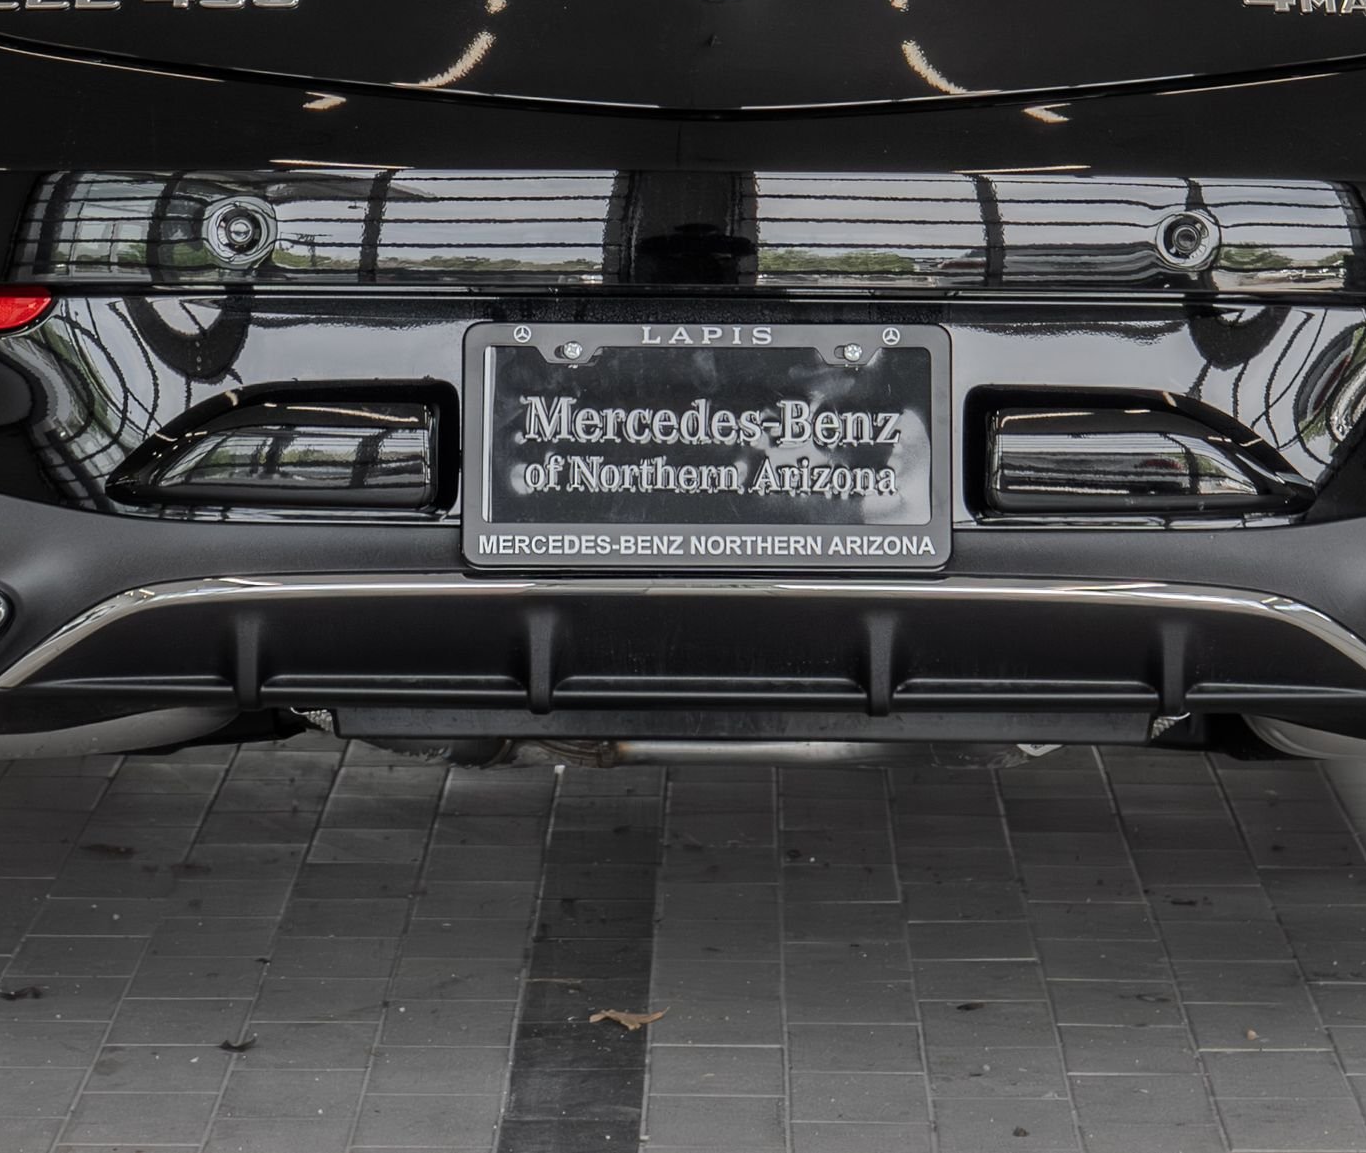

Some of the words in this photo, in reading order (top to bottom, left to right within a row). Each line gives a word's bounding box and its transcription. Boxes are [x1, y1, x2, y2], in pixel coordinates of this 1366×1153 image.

[641, 326, 774, 346] LAPIS
[520, 395, 902, 444] Mercedes-Benz
[523, 454, 564, 490] of
[568, 455, 741, 492] Northern
[751, 457, 898, 495] Arizona
[478, 535, 684, 556] MERCEDES-BENZ
[690, 536, 823, 556] NORTHERN
[828, 536, 936, 556] ARIZONA
